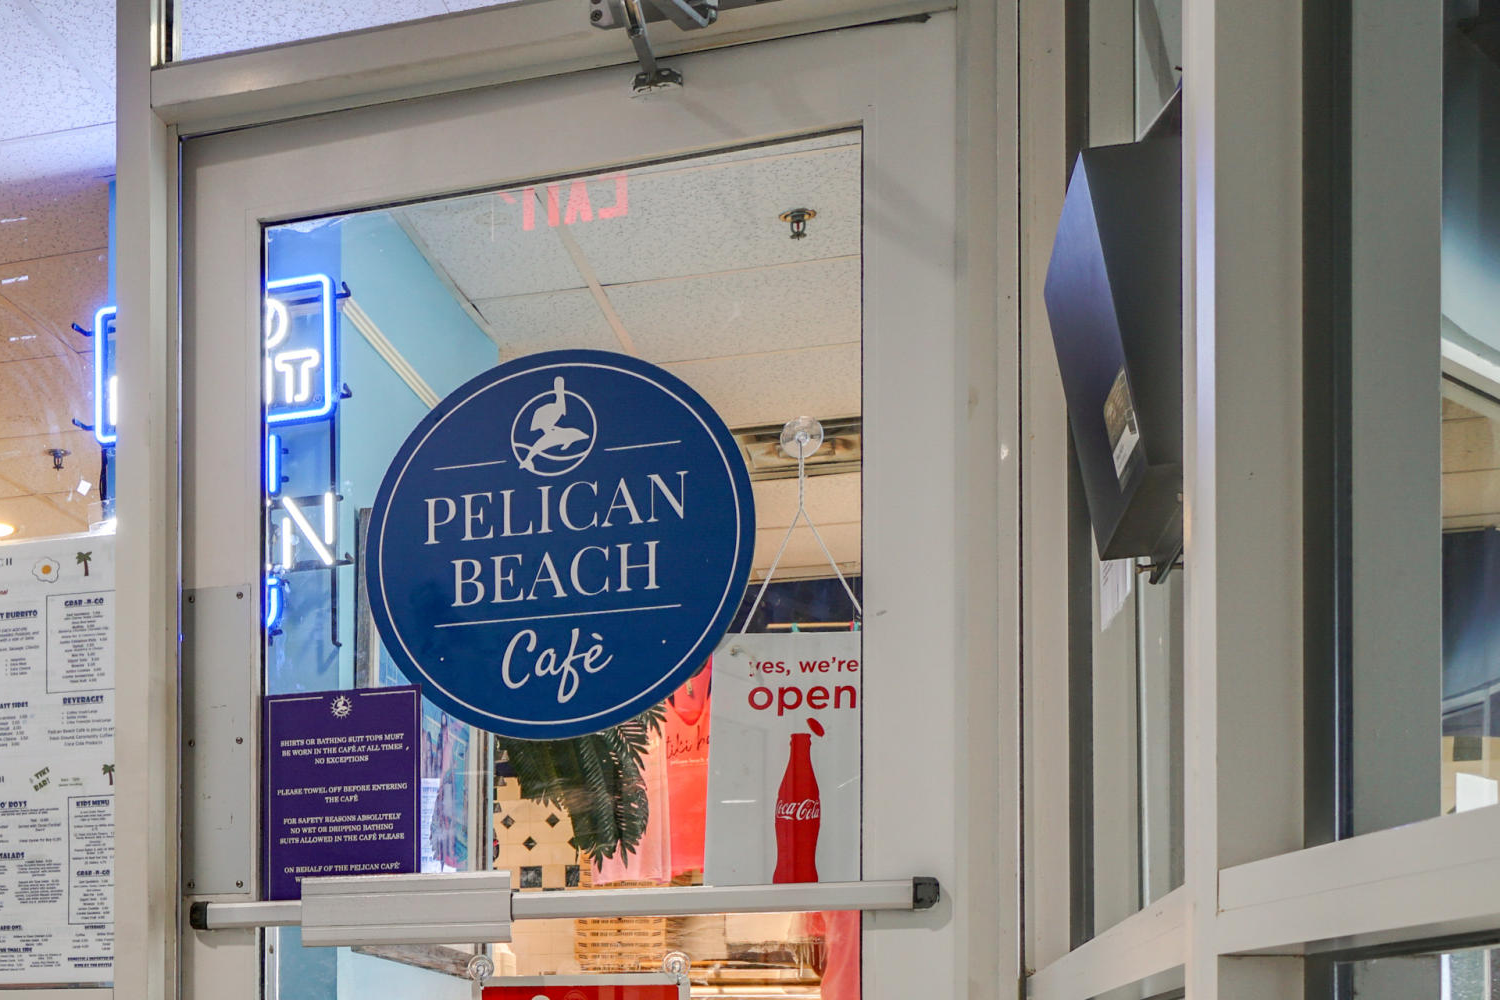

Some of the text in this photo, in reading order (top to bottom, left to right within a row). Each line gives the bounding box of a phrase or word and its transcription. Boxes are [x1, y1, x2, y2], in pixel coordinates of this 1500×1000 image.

[424, 470, 689, 545] PELICAN
[450, 540, 660, 607] BEACH
[6, 610, 38, 620] BURRITO
[748, 657, 859, 677] yes, we're
[62, 695, 104, 704] BEVERAGES
[748, 685, 857, 717] open
[317, 736, 347, 745] BATHING
[348, 735, 365, 743] SUIT
[365, 734, 383, 742] TOPS
[384, 733, 404, 741] MUST
[292, 748, 312, 756] WORN
[313, 747, 322, 755] IN
[357, 745, 366, 753] AT
[366, 744, 380, 752] ALL
[381, 743, 403, 751] TIMES
[326, 755, 369, 765] EXCEPTIONS
[277, 782, 408, 796] PLEASE TOWEL OFF BEFORE ENTERING
[8, 800, 27, 808] BOYS
[298, 816, 324, 824] SAFETY
[324, 814, 356, 823] REASONS
[357, 812, 402, 822] ABSOLUTELY
[317, 825, 327, 833] OR
[328, 824, 362, 833] DRIPPING
[362, 823, 394, 831] BATHING
[279, 837, 299, 845] SUITS
[300, 835, 333, 844] ALLOWED
[343, 834, 358, 842] THE
[378, 832, 405, 840] PLEASE
[0, 852, 25, 860] SALADS
[295, 865, 322, 873] BEHALF
[323, 864, 333, 872] OF
[349, 863, 380, 871] PELICAN
